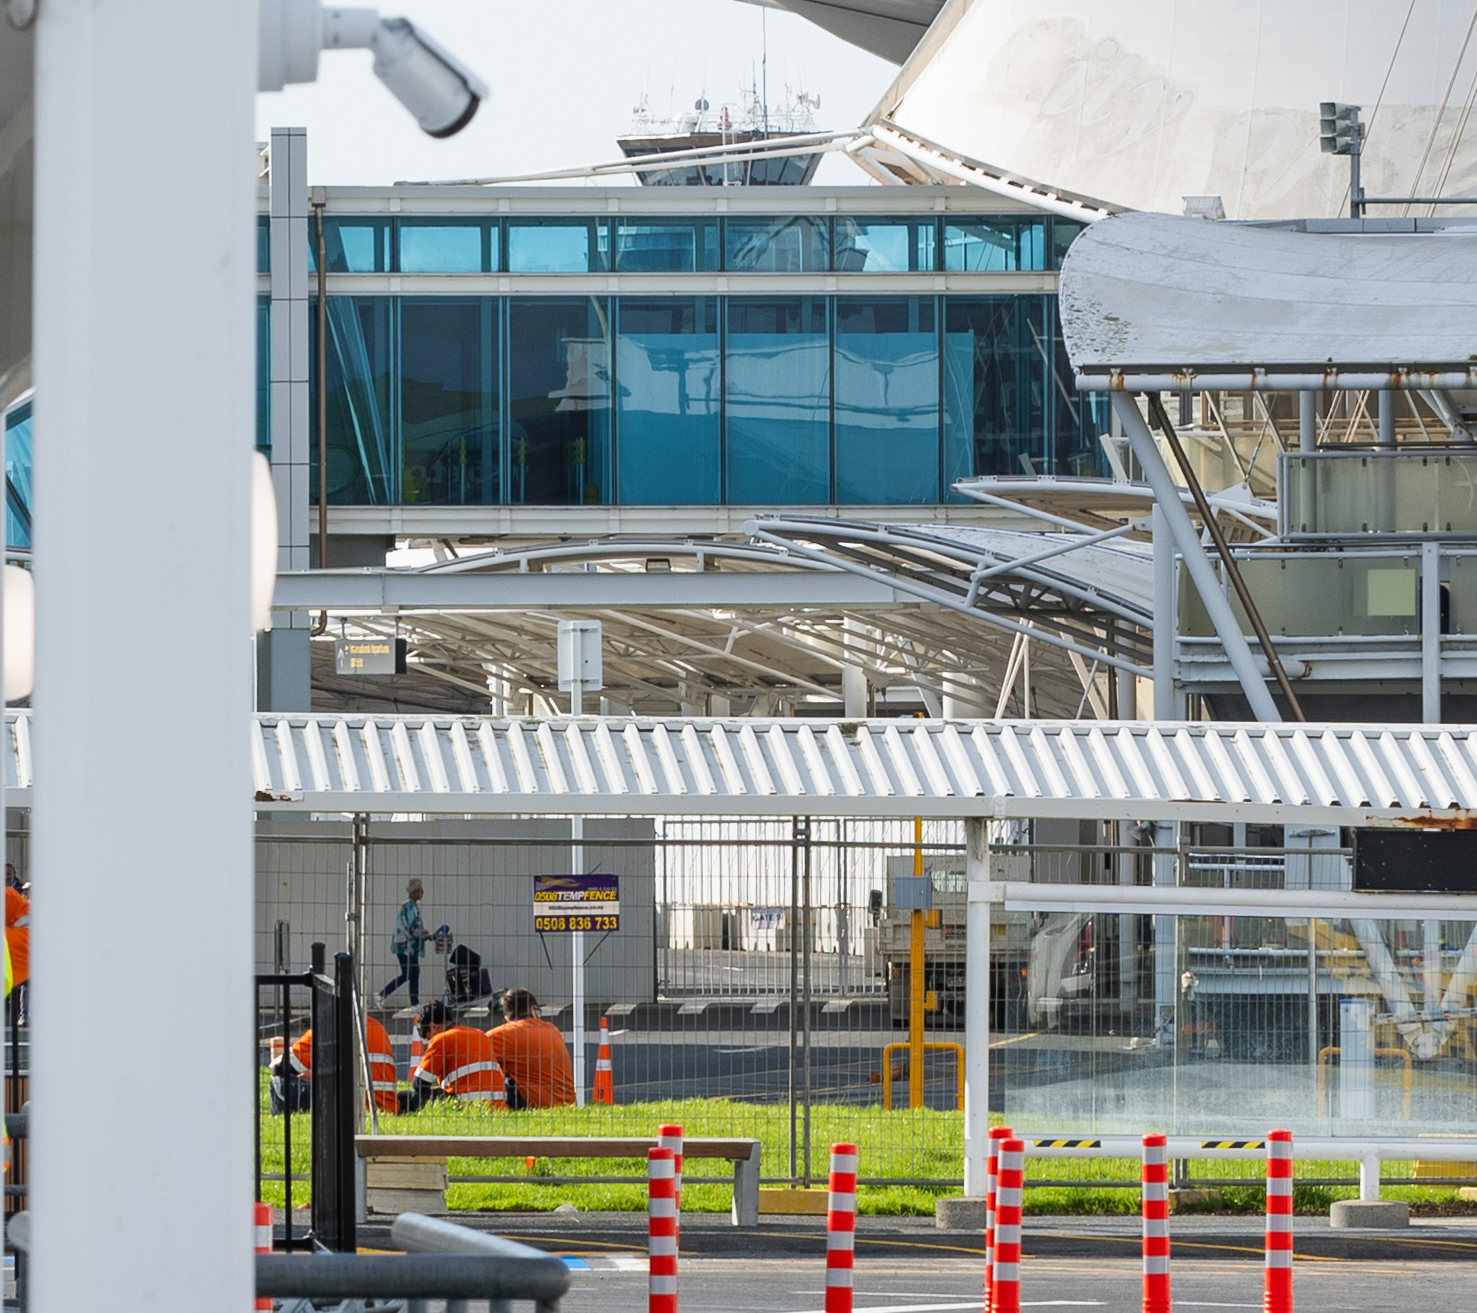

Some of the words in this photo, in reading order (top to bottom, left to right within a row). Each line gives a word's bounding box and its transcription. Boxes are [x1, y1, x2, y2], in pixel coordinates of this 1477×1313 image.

[535, 917, 566, 931] 0508
[569, 917, 591, 930] 836
[595, 916, 617, 930] 733
